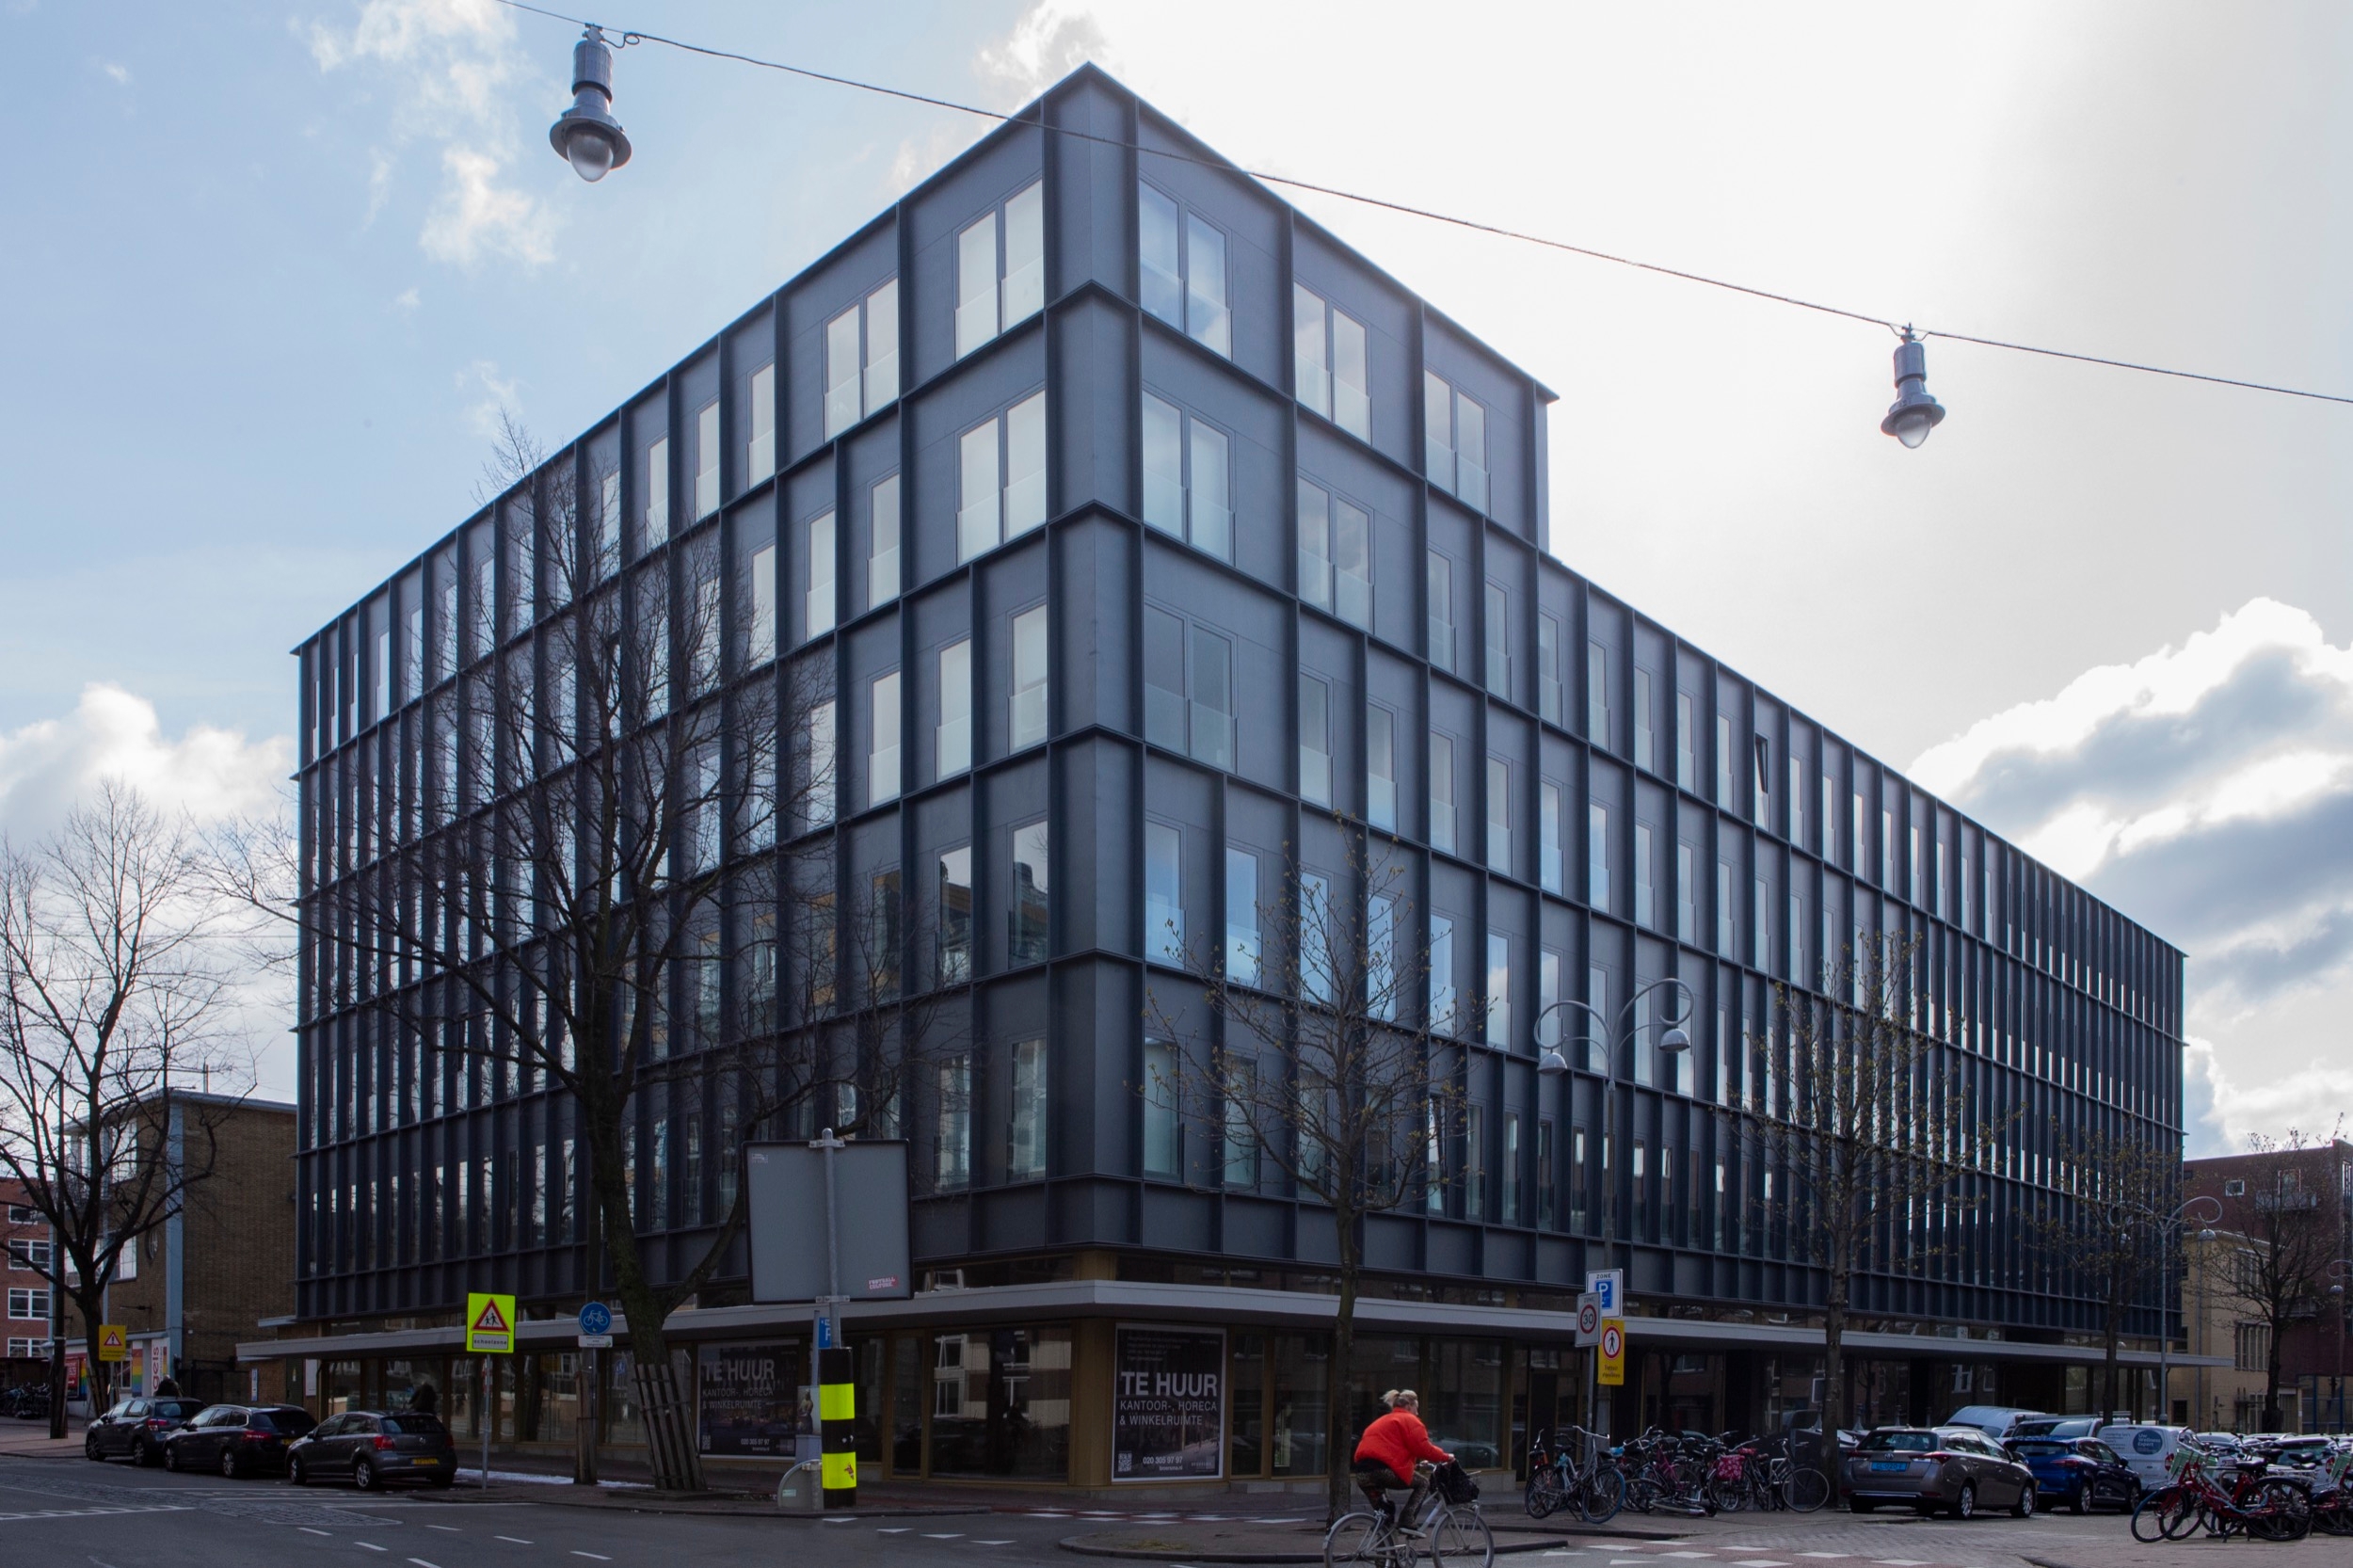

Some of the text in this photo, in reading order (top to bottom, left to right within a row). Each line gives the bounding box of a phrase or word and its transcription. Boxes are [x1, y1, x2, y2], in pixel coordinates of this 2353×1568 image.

[1599, 1283, 1609, 1295] P
[1583, 1313, 1593, 1325] 30
[702, 1359, 775, 1382] TE HUUR
[1121, 1370, 1217, 1397] TE HUUR
[744, 1387, 774, 1397] HORECA
[709, 1400, 762, 1410] WINKELRUIMTE
[1120, 1400, 1217, 1413] KANTOOR-, HORECA
[1119, 1415, 1203, 1426] & WINKELRUIMTE
[1143, 1456, 1154, 1464] 020
[1155, 1456, 1166, 1464] 305
[1167, 1456, 1175, 1464] 97
